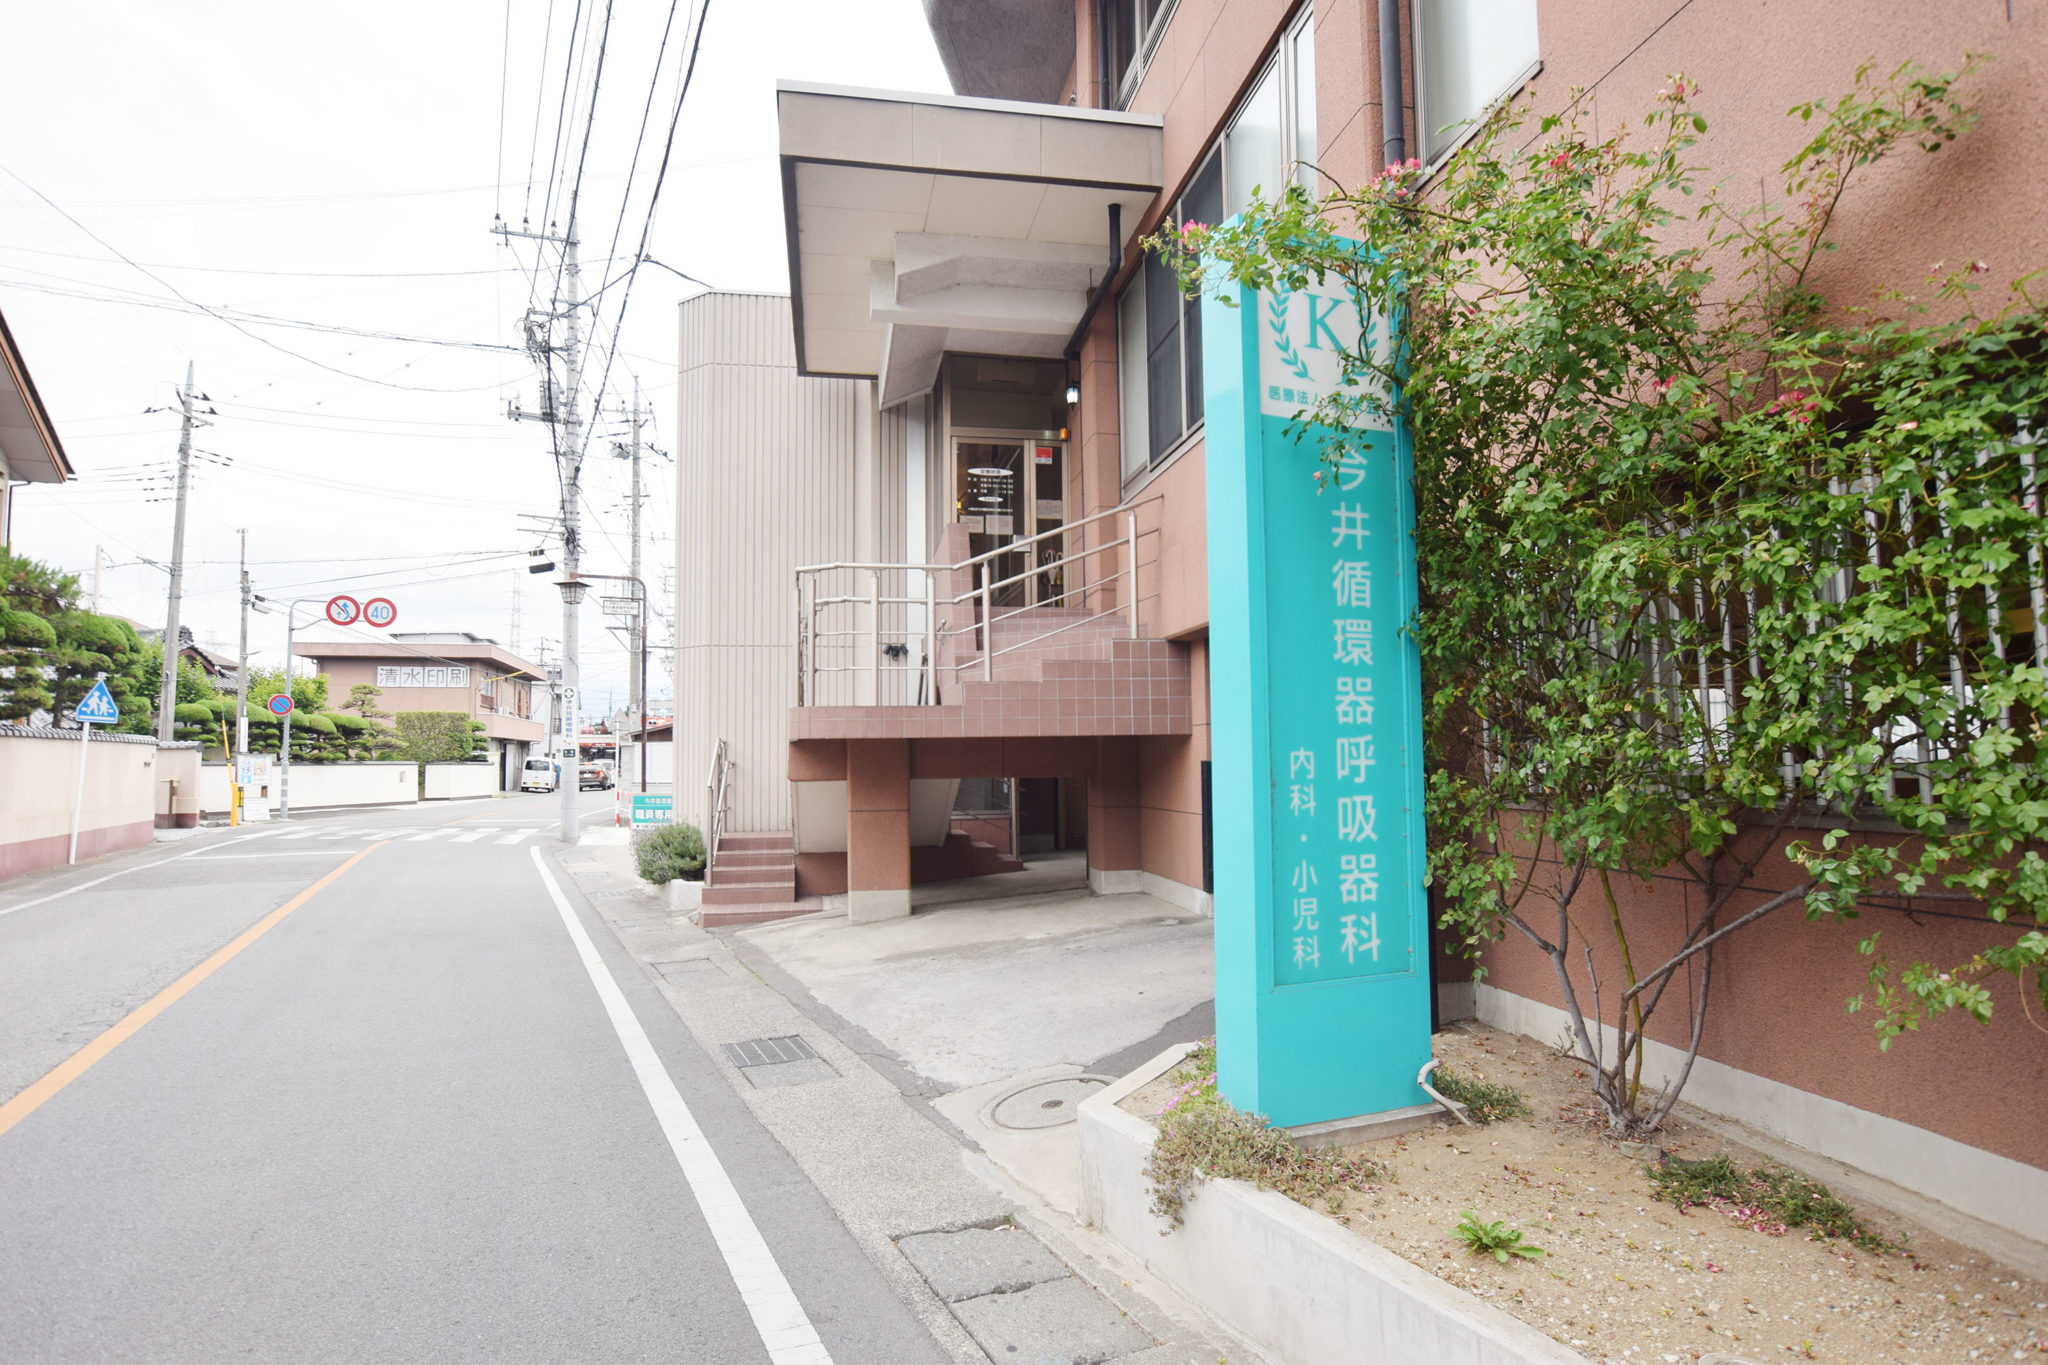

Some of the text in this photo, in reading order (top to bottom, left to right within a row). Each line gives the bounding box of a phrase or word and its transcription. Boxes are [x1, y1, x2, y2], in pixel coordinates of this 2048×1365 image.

[1304, 292, 1347, 351] K
[370, 605, 390, 620] 40
[378, 667, 469, 687] 清水印刷
[1331, 443, 1381, 964] 今井循環器呼吸器科
[1289, 747, 1321, 969] 内科・小児科
